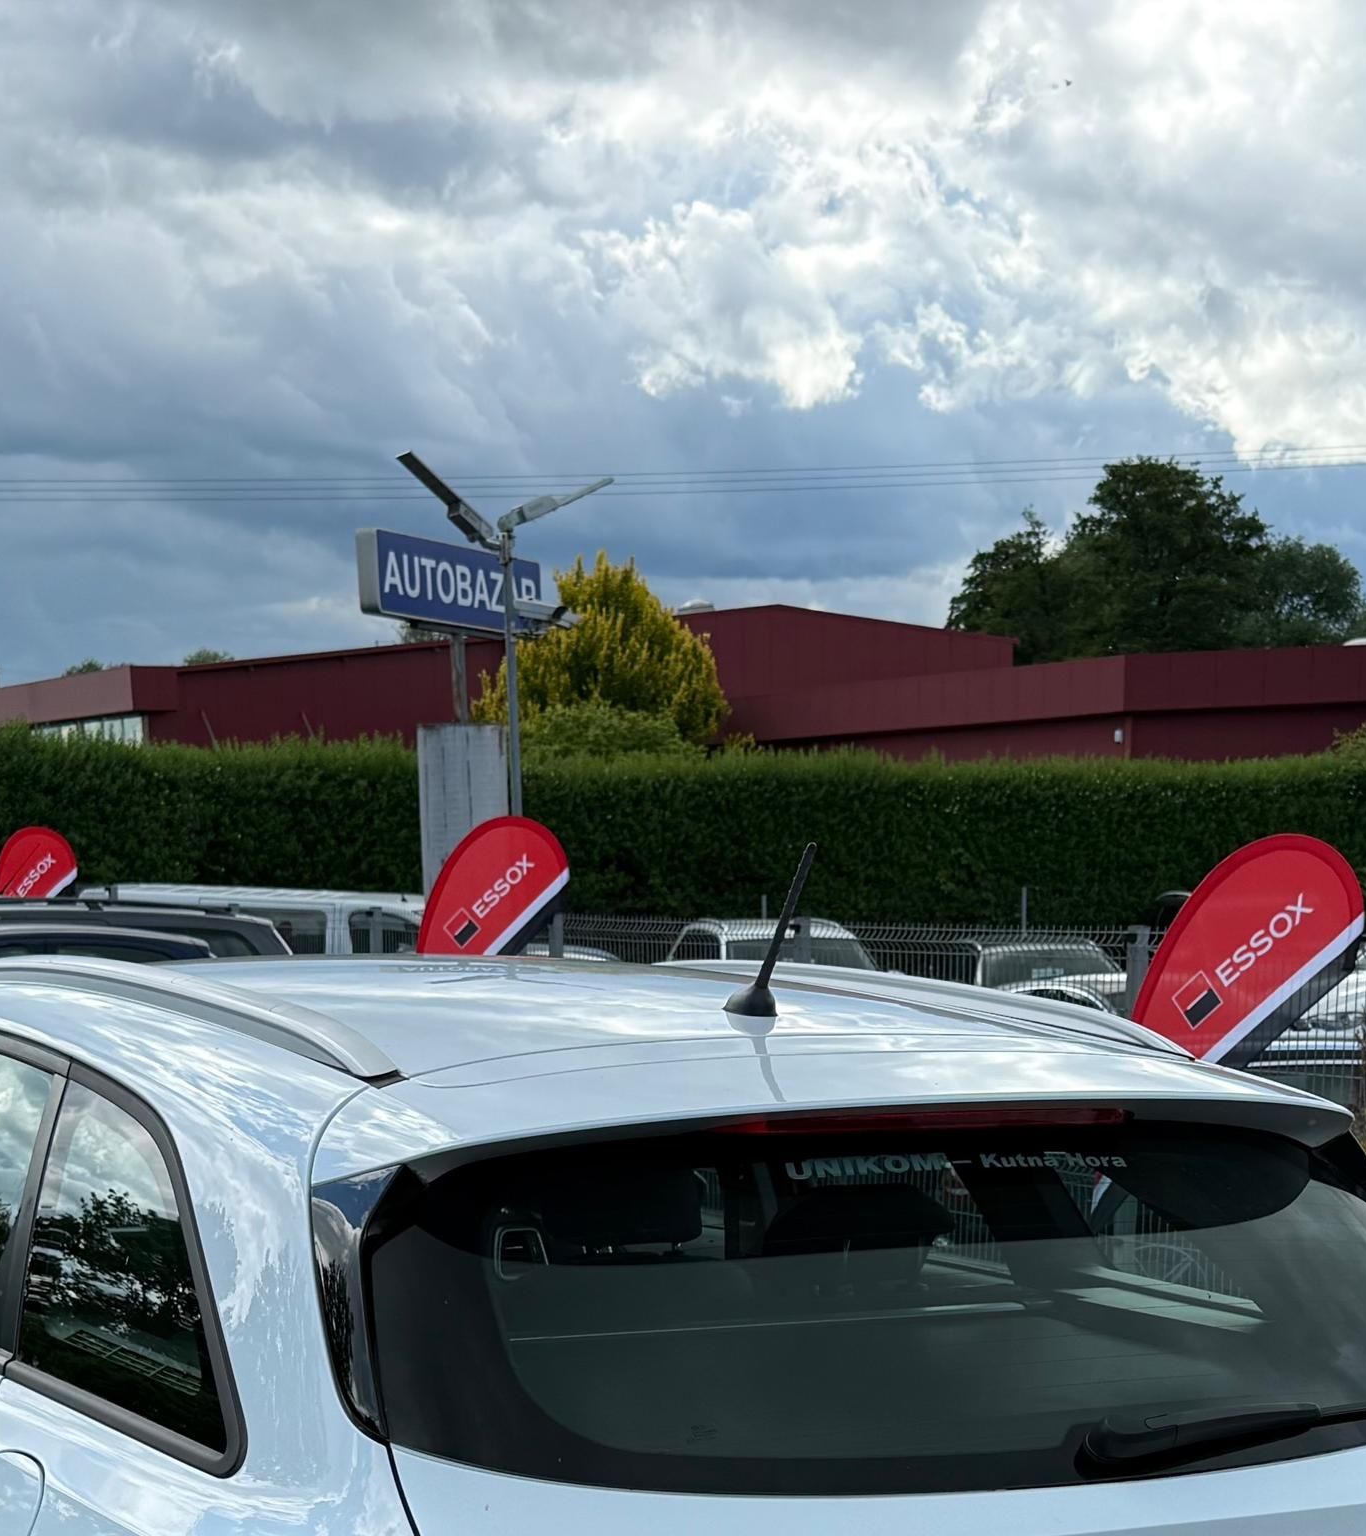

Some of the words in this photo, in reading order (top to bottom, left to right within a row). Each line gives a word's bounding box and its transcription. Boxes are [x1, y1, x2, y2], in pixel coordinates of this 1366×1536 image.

[16, 852, 57, 898] ESSOX
[472, 853, 536, 919] ESSOX
[1214, 892, 1314, 988] ESSOX
[785, 1152, 945, 1180] UNIKOM
[1065, 1152, 1128, 1168] Hora
